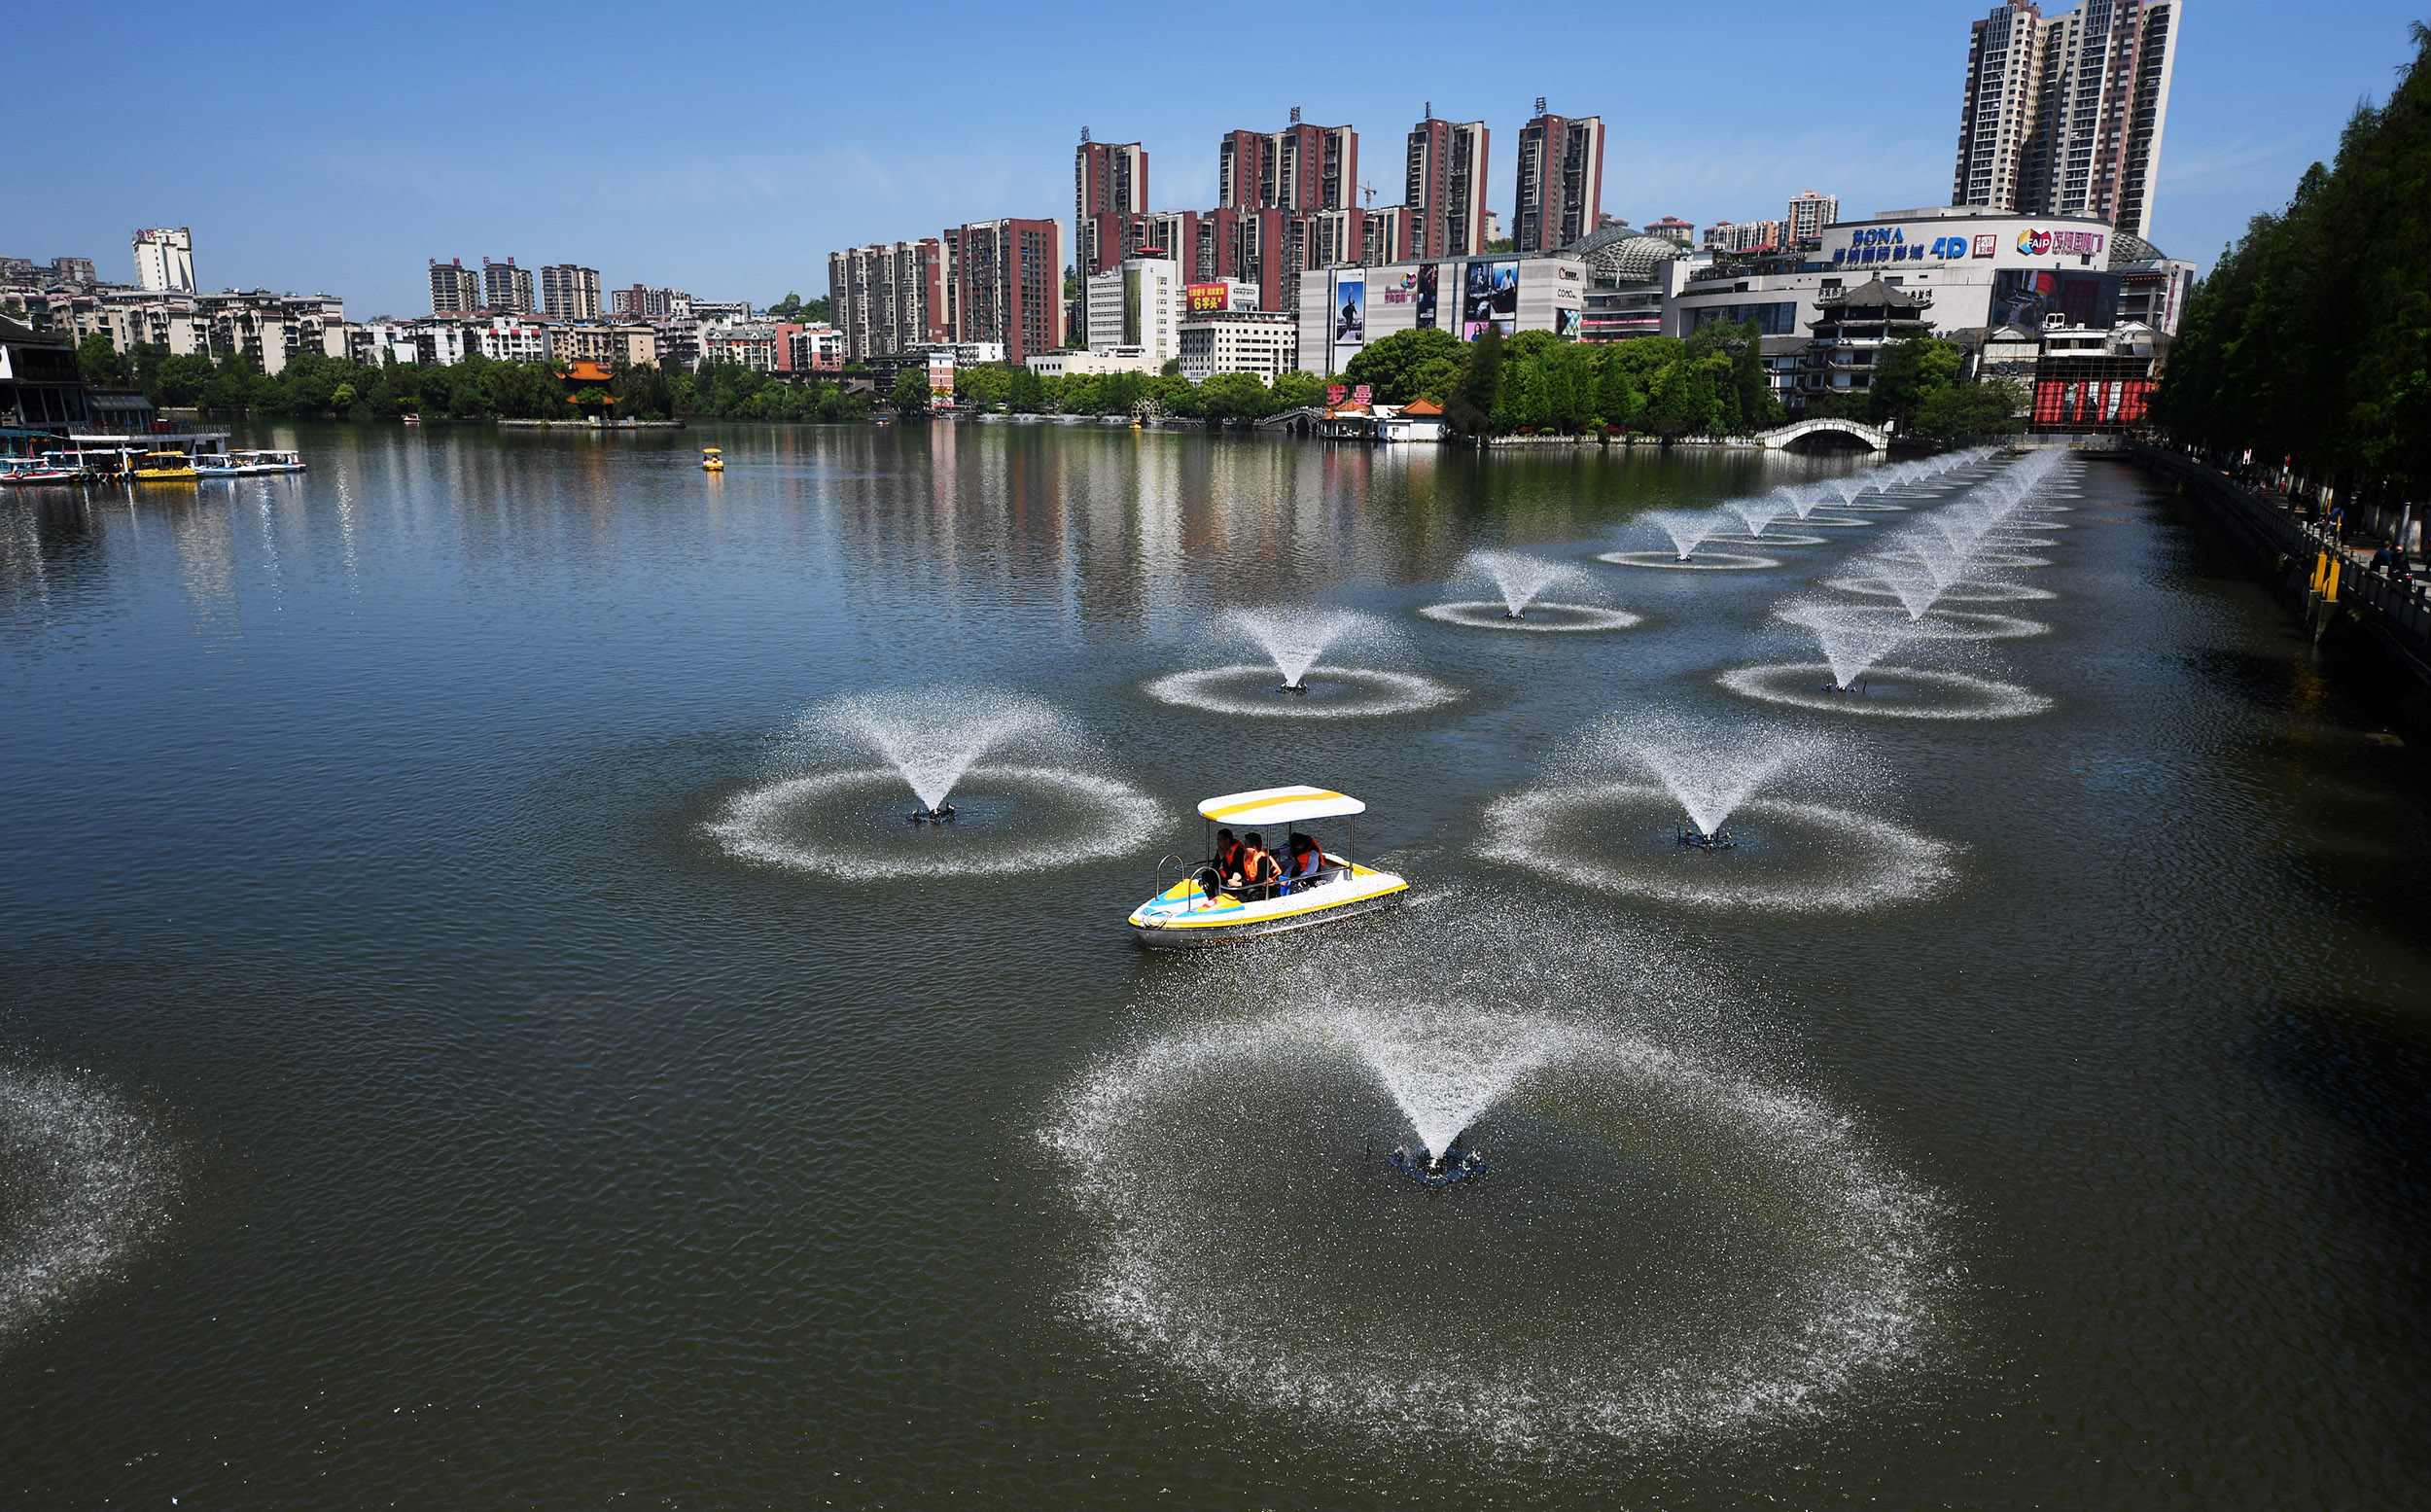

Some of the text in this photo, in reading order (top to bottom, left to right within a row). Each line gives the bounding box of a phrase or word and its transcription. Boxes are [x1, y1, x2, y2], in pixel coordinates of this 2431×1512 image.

[1533, 97, 1546, 114] 号
[1852, 227, 1904, 246] BONA
[1929, 236, 1968, 259] 4D
[1326, 385, 1372, 405] 罗曼
